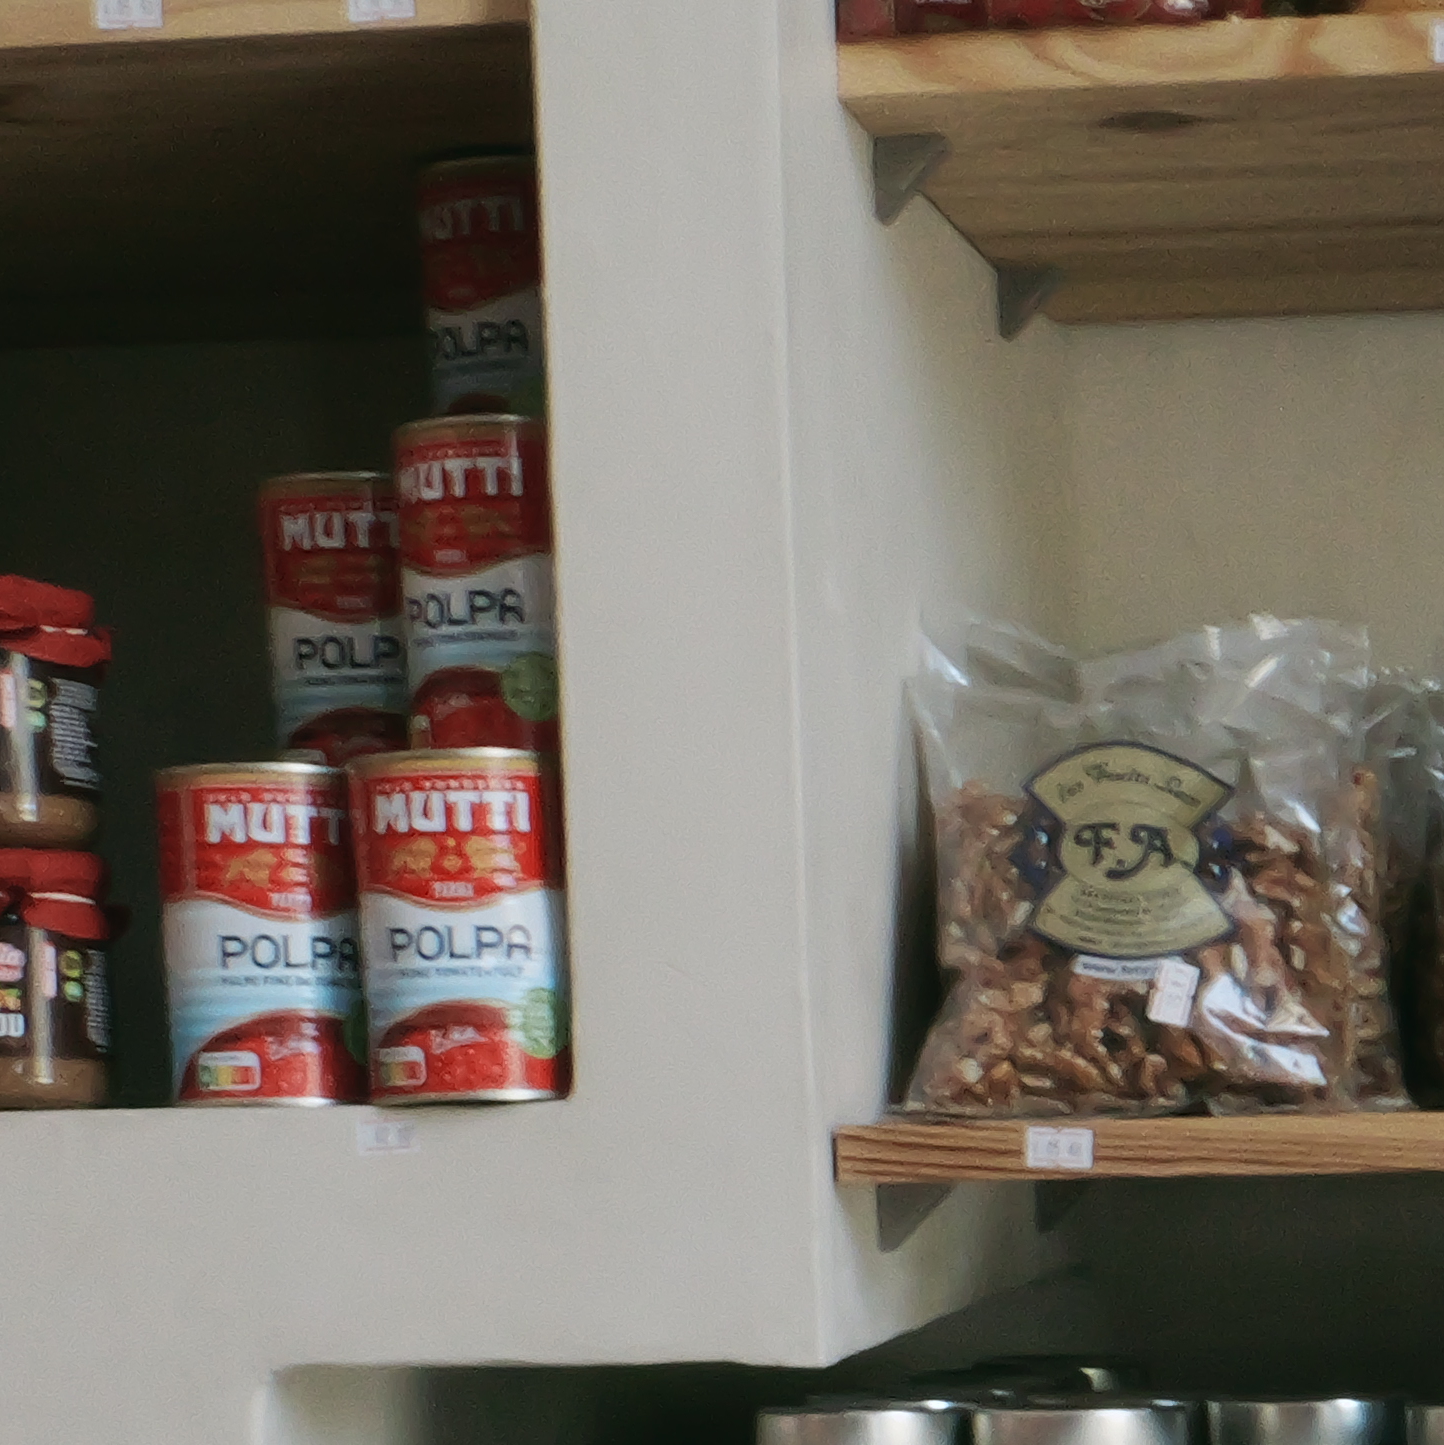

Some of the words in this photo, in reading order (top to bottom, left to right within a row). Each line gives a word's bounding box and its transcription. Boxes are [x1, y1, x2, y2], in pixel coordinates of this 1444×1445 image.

[280, 513, 400, 552] MUTT
[406, 589, 526, 638] POLPA
[294, 637, 400, 672] POLP
[204, 802, 350, 846] MUTT
[373, 790, 532, 835] MUTTI
[388, 924, 533, 963] POLPA
